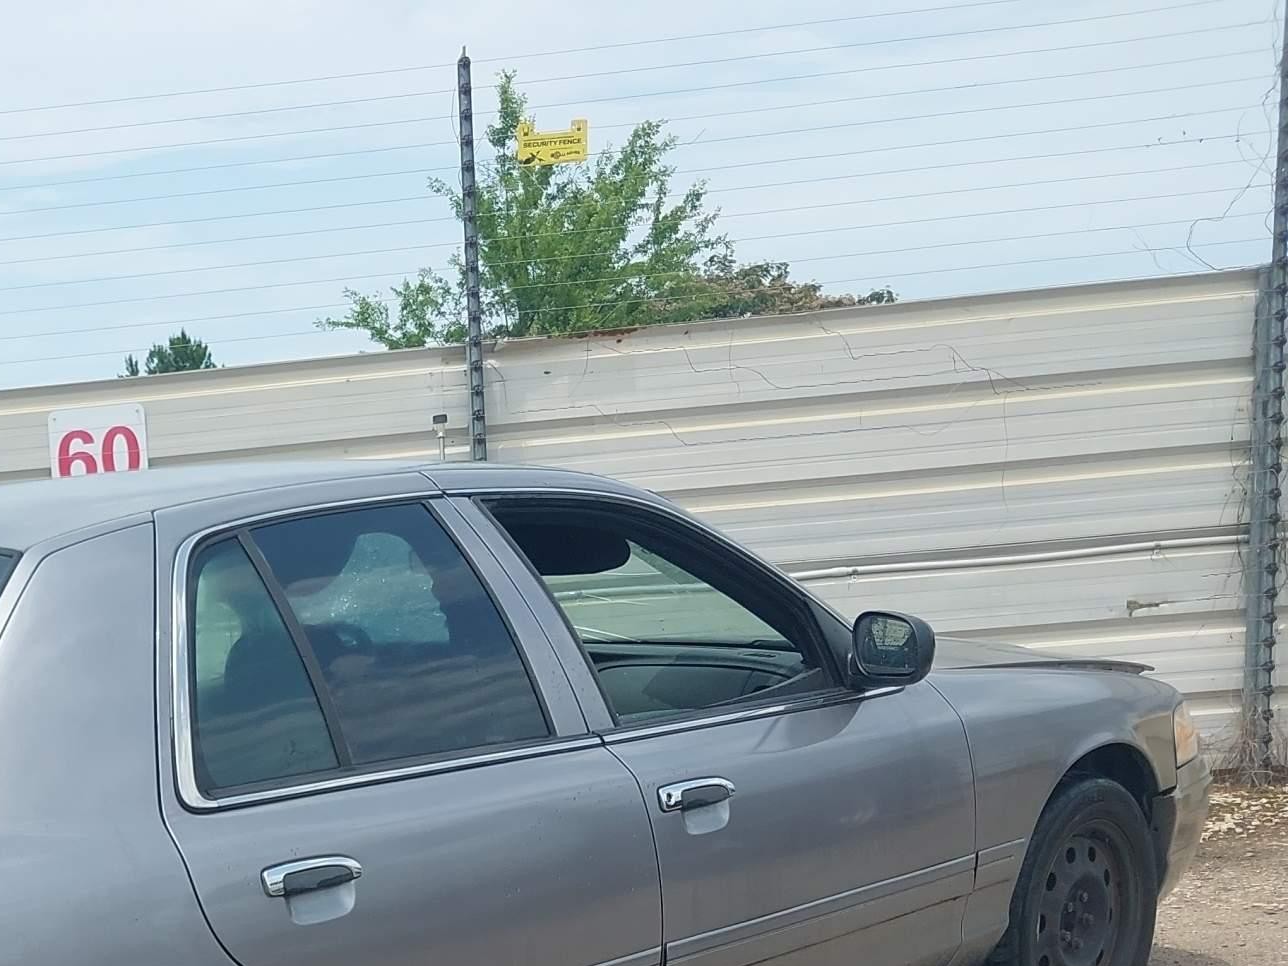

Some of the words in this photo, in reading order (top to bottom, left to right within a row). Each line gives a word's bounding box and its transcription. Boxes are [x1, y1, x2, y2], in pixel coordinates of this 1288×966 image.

[523, 140, 558, 148] SECURITY
[559, 138, 582, 146] FENCE
[58, 426, 140, 477] 60
